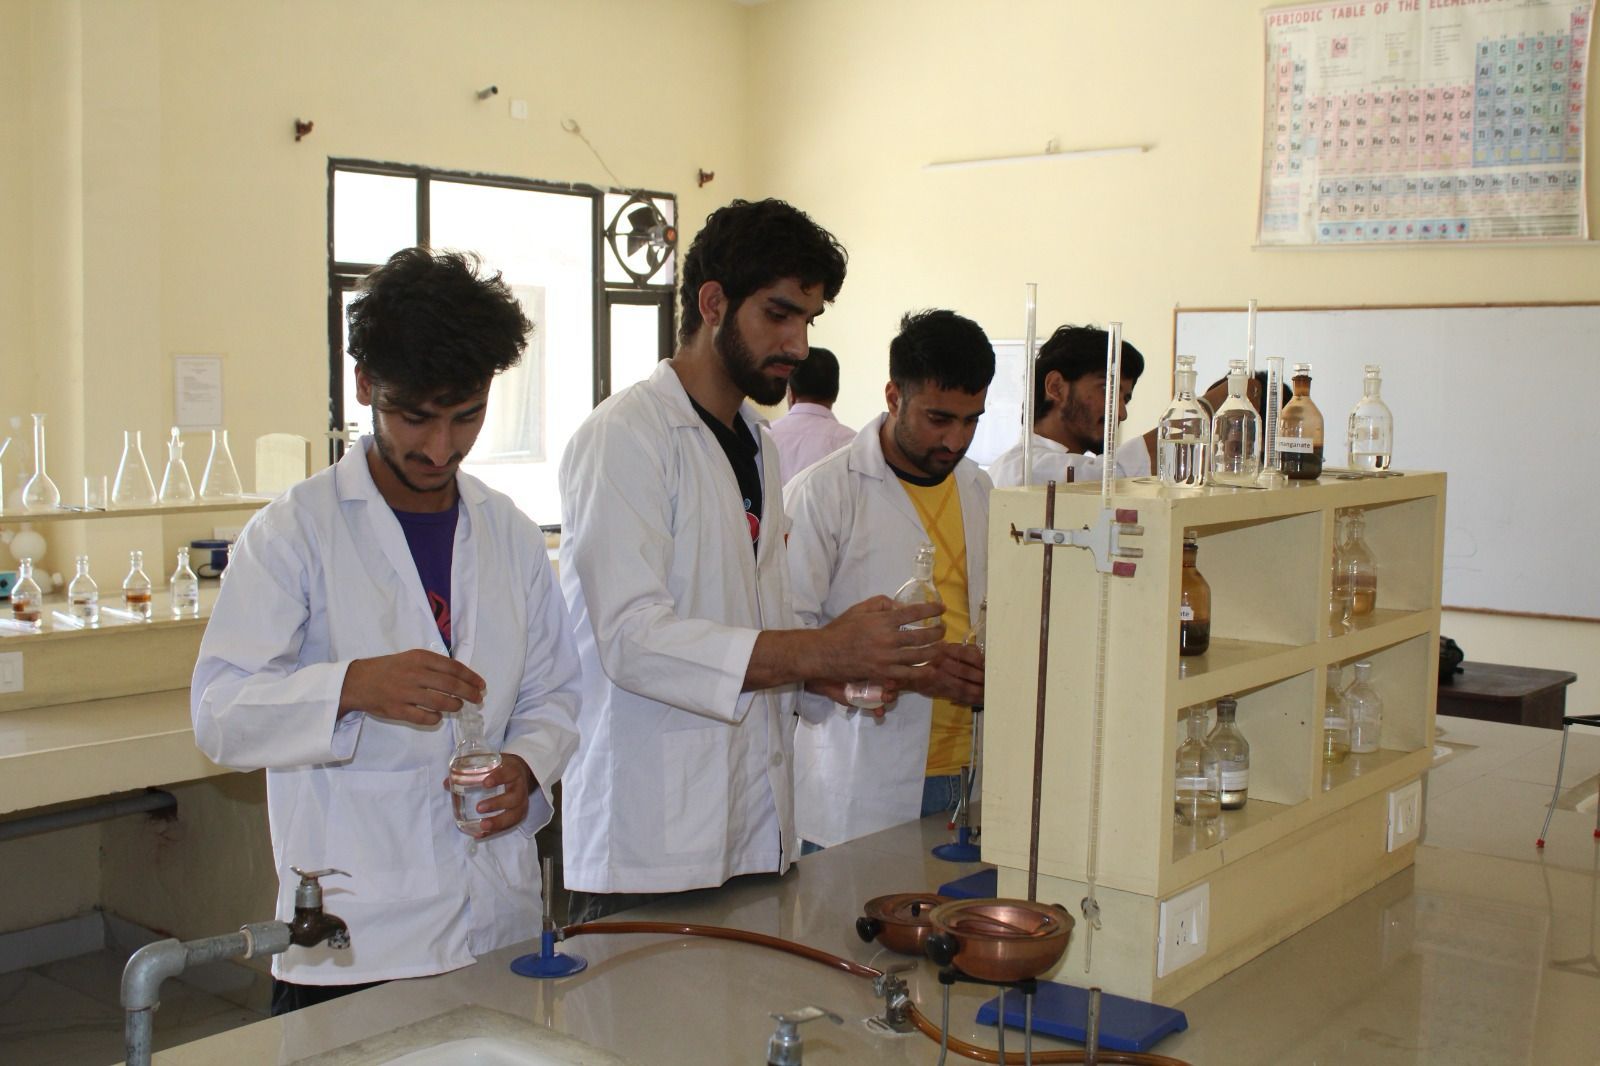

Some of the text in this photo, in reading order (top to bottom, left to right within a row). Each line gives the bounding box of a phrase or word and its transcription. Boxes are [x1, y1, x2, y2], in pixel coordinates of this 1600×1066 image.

[1269, 9, 1322, 26] PERIODIC
[1331, 5, 1365, 19] TABLE
[1374, 2, 1389, 15] OF
[1399, 0, 1419, 12] THE
